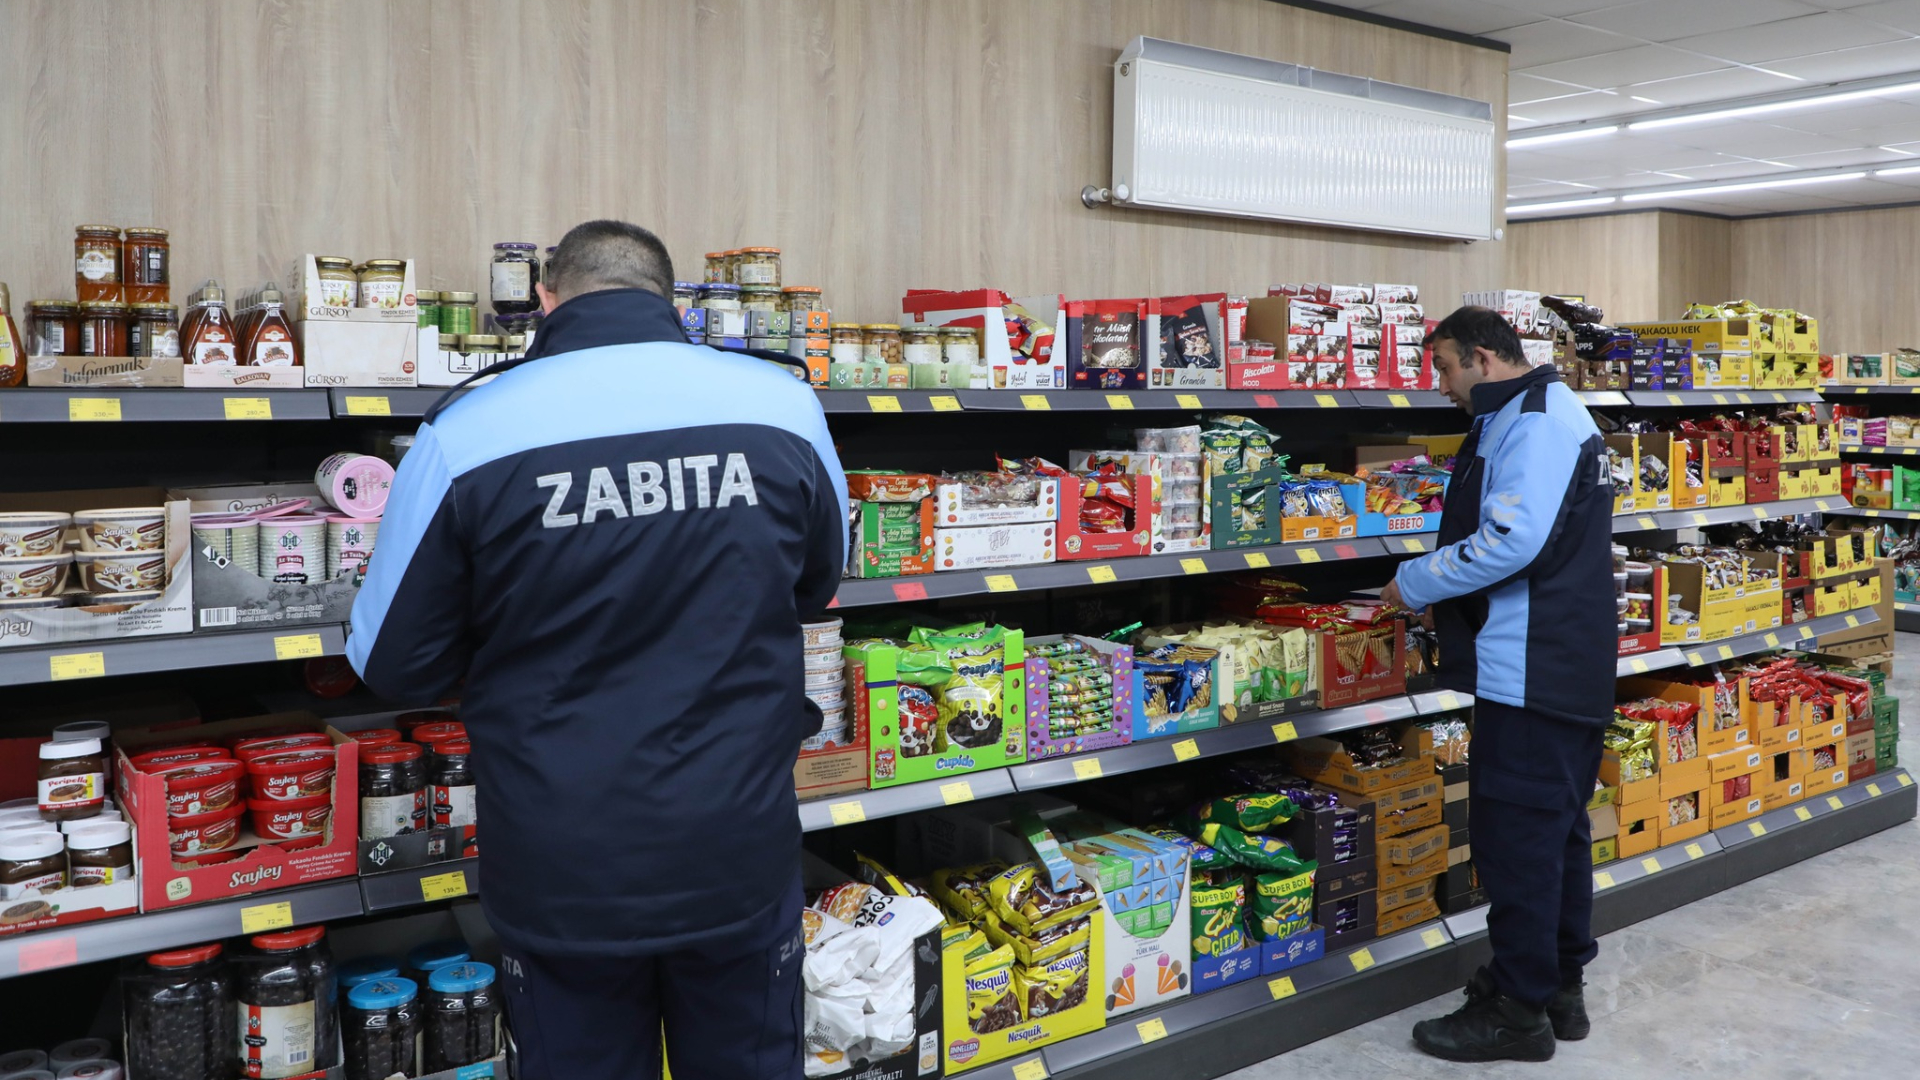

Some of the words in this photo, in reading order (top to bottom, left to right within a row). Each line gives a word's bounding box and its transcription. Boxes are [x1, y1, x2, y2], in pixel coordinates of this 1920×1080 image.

[310, 306, 350, 318] GÜRSOY
[1106, 323, 1132, 333] Müsli
[1634, 326, 1679, 337] KAKAOLU
[1681, 325, 1701, 334] KEK
[1575, 342, 1594, 350] APPS
[63, 357, 146, 386] balparmak
[1243, 364, 1276, 379] Biscolata
[235, 372, 271, 385] BALKOVAN
[307, 374, 348, 386] GÜRSOY
[1179, 375, 1207, 386] Granola
[536, 453, 758, 528] ZABITA
[1388, 516, 1425, 531] BEBETO
[103, 527, 134, 538] Sayley
[103, 564, 134, 575] Sayley
[117, 608, 143, 616] Kakaolu
[151, 752, 200, 763] Sayley
[936, 755, 975, 770] Cupido
[48, 776, 88, 788] Peripella
[268, 775, 298, 787] Sayley
[170, 791, 200, 804] Sayley
[272, 811, 303, 823] Sayley
[176, 829, 199, 842] ayley
[289, 857, 312, 865] Kakaolu
[312, 853, 333, 861] Fındıklı
[333, 850, 352, 858] Krema
[25, 874, 63, 890] Peripella
[229, 864, 283, 889] Sayley
[1264, 883, 1291, 895] SÜPER
[1292, 877, 1307, 889] BOY
[1192, 892, 1219, 904] SÜPER
[1220, 890, 1234, 900] BOY
[38, 916, 58, 925] Krema
[1278, 915, 1310, 941] ÇITIR
[1211, 930, 1240, 958] ÇITIR
[1046, 950, 1086, 974] Nesquik
[966, 970, 1010, 991] Nesquik
[1008, 1024, 1042, 1043] Nesquik
